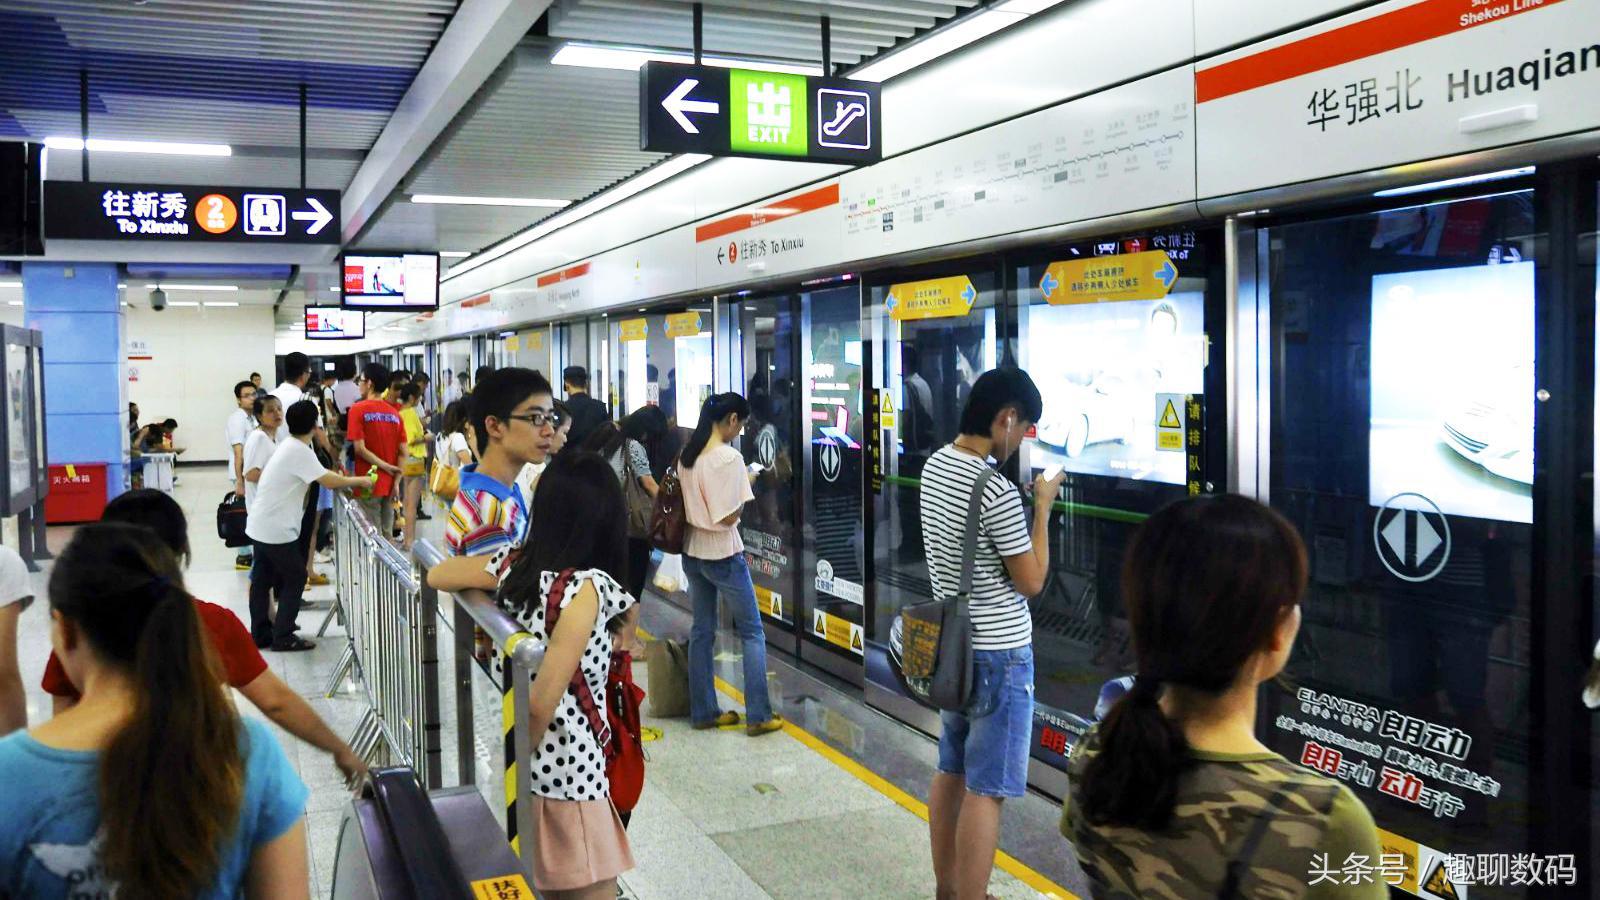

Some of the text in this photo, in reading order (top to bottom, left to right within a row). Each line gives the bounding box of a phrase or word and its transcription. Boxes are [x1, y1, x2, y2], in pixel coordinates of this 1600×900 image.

[1459, 3, 1510, 27] Shekou
[1306, 68, 1424, 132] 华强北
[748, 126, 790, 144] EXIT
[102, 189, 224, 219] 往新秀 2
[116, 218, 134, 233] To
[139, 219, 189, 235] Xinxiu
[740, 238, 767, 261] 往新秀
[770, 240, 780, 254] To
[781, 238, 804, 252] Xinxiu
[1297, 686, 1381, 723] ELANTRA
[1378, 710, 1473, 762] 朗动
[1301, 740, 1466, 818] 朗于心 动于行
